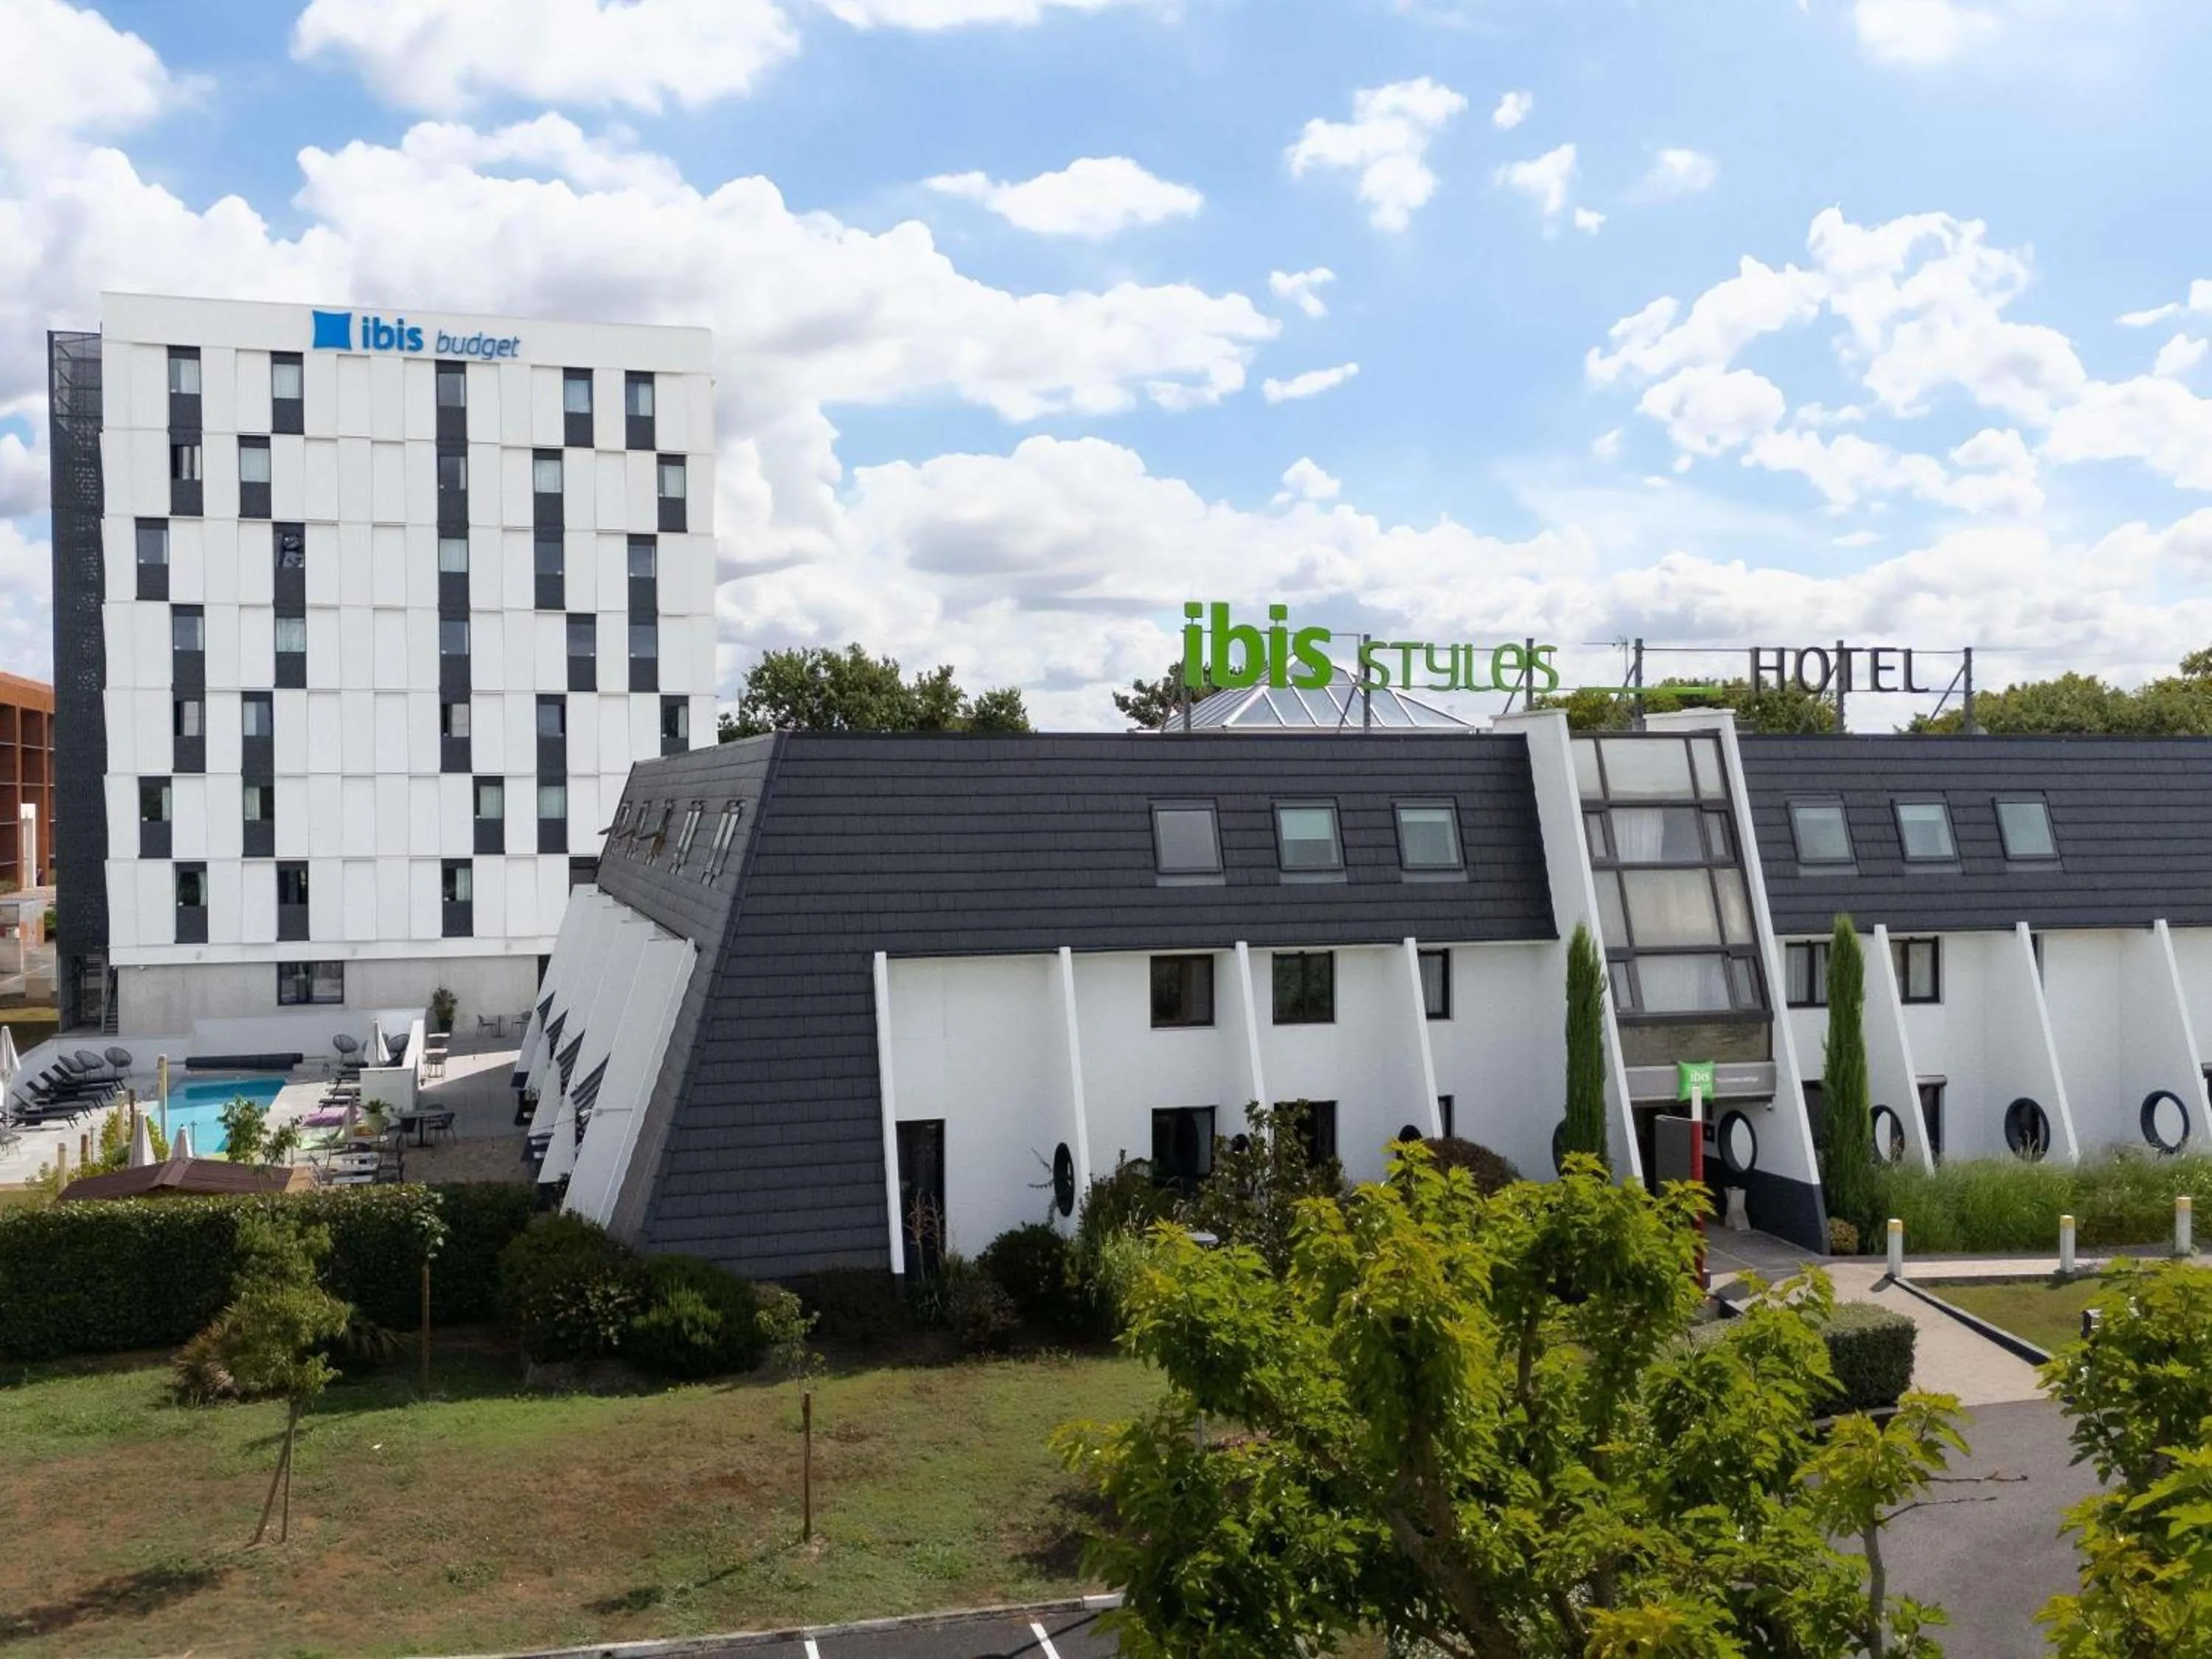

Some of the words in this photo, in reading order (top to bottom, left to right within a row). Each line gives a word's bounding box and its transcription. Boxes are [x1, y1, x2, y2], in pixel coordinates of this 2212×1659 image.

[362, 316, 424, 352] ibis
[435, 330, 521, 360] budget
[1183, 601, 1334, 690] ibis
[1750, 646, 1930, 694] HOTEL
